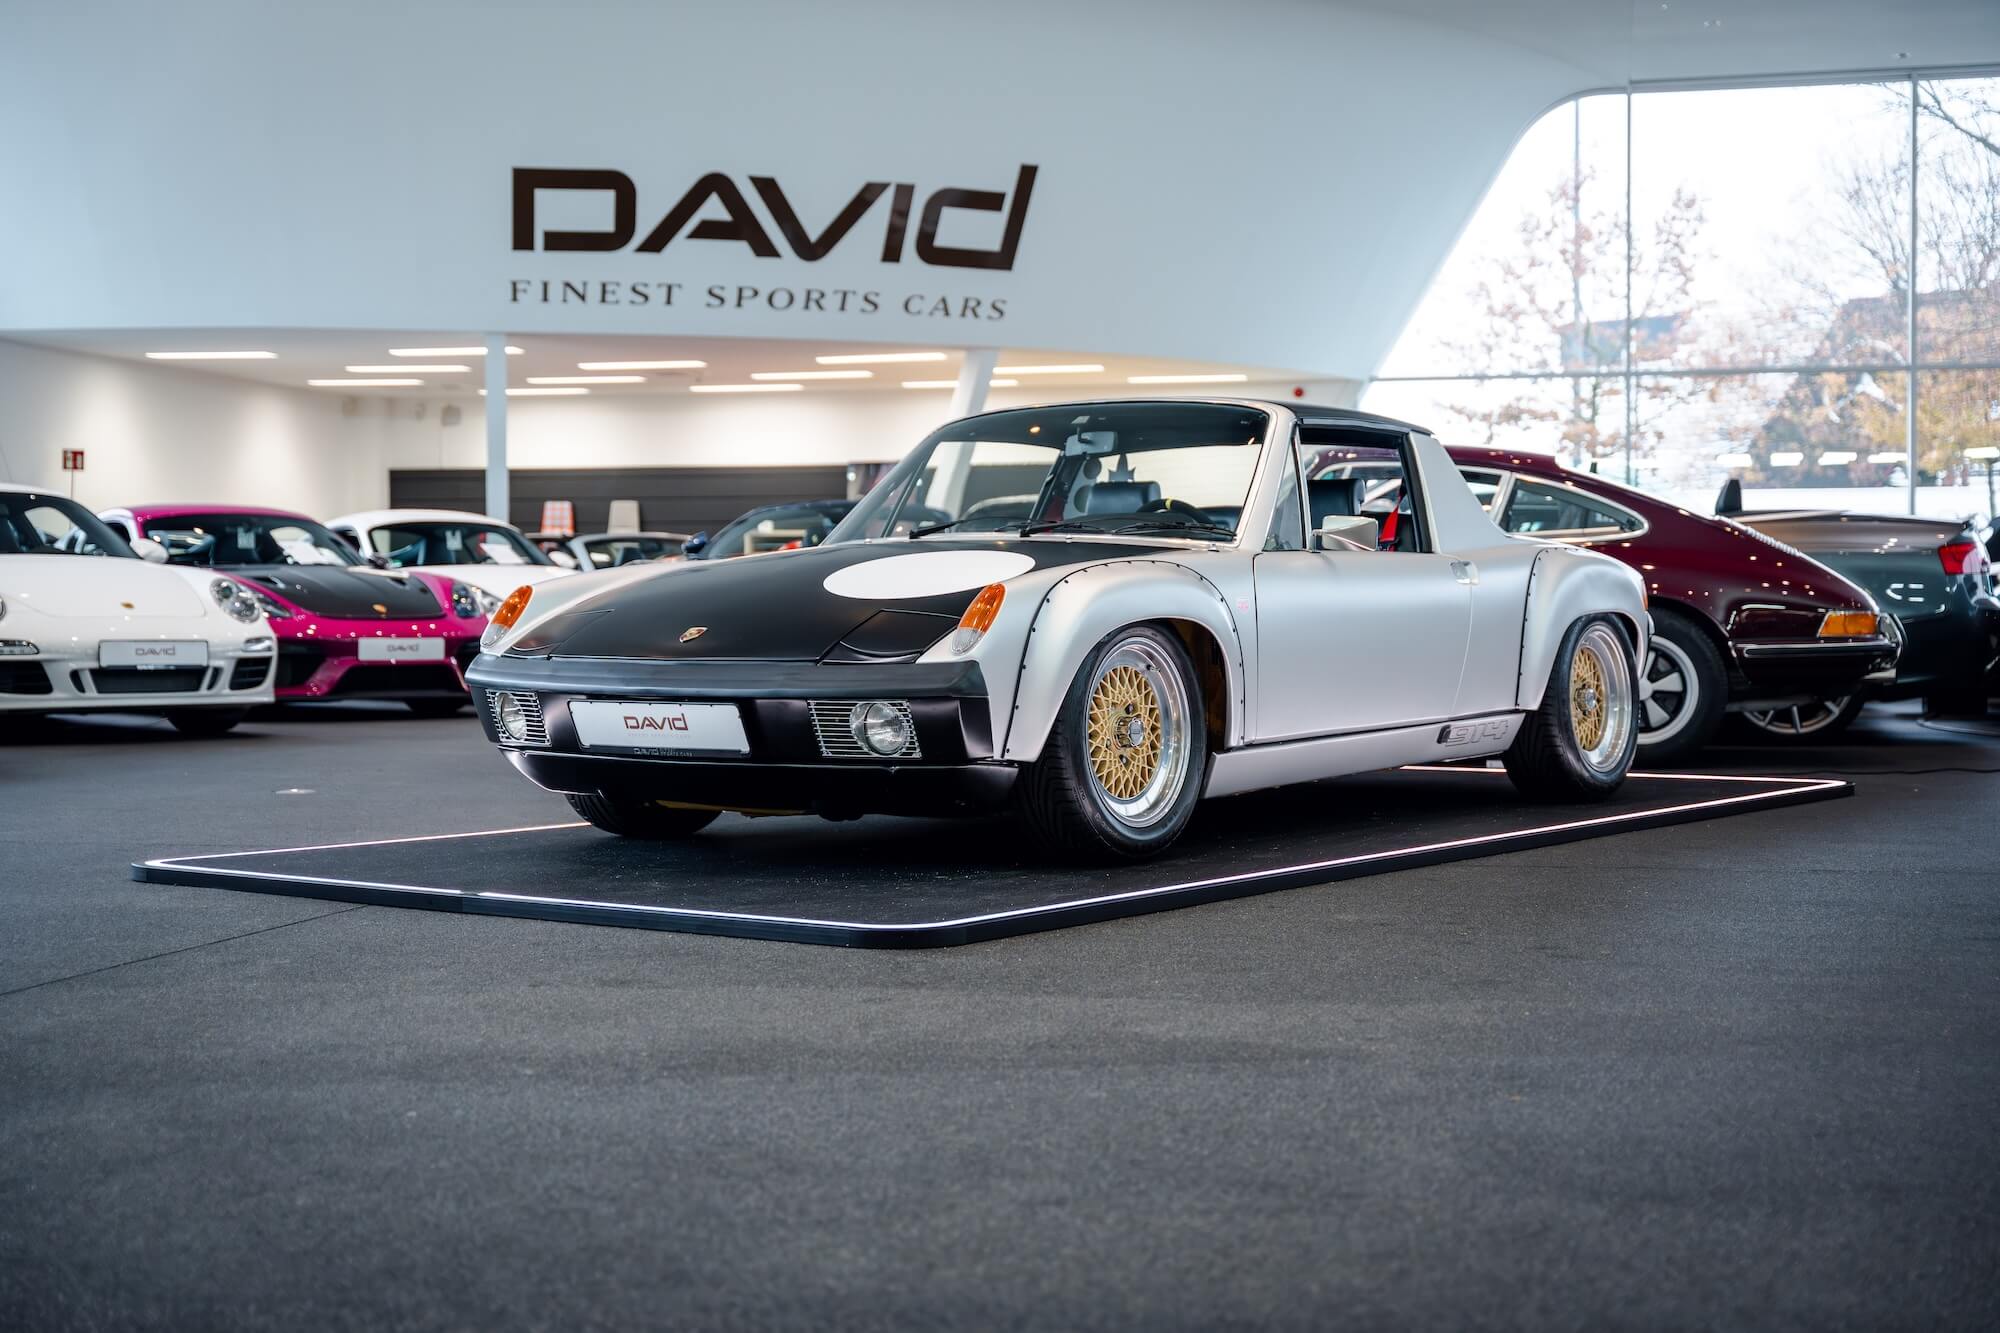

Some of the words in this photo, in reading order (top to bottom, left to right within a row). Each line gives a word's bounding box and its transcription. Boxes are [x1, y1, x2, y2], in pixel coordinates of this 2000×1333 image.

[510, 280, 683, 306] FINEST
[706, 285, 881, 314] SPORTS
[903, 293, 1008, 321] CARS
